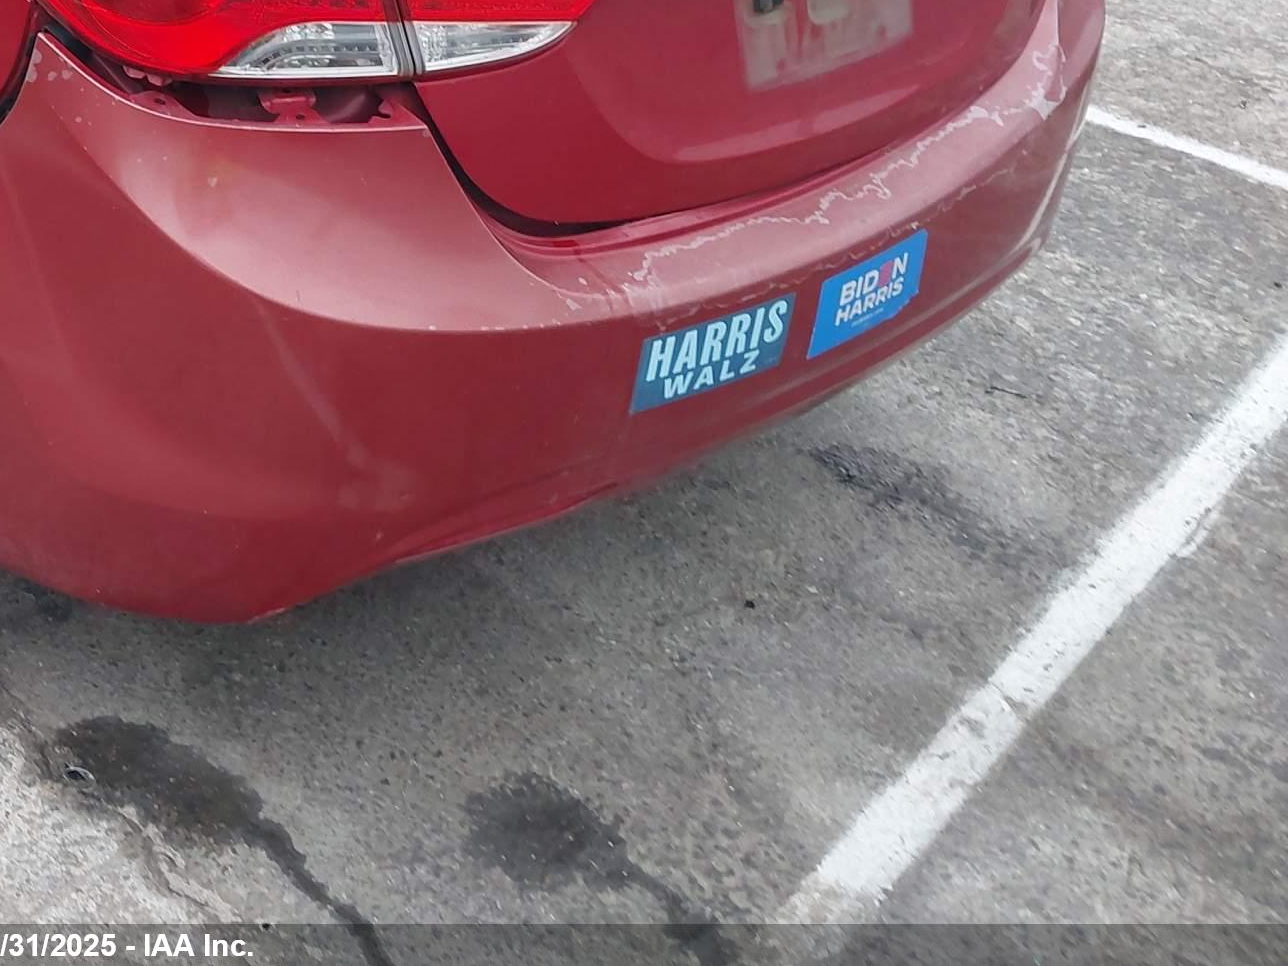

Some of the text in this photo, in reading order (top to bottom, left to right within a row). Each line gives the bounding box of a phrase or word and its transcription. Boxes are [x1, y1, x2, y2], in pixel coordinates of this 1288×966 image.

[834, 276, 905, 327] HARRIS
[645, 300, 788, 382] HARRIS
[664, 349, 760, 399] WALZ
